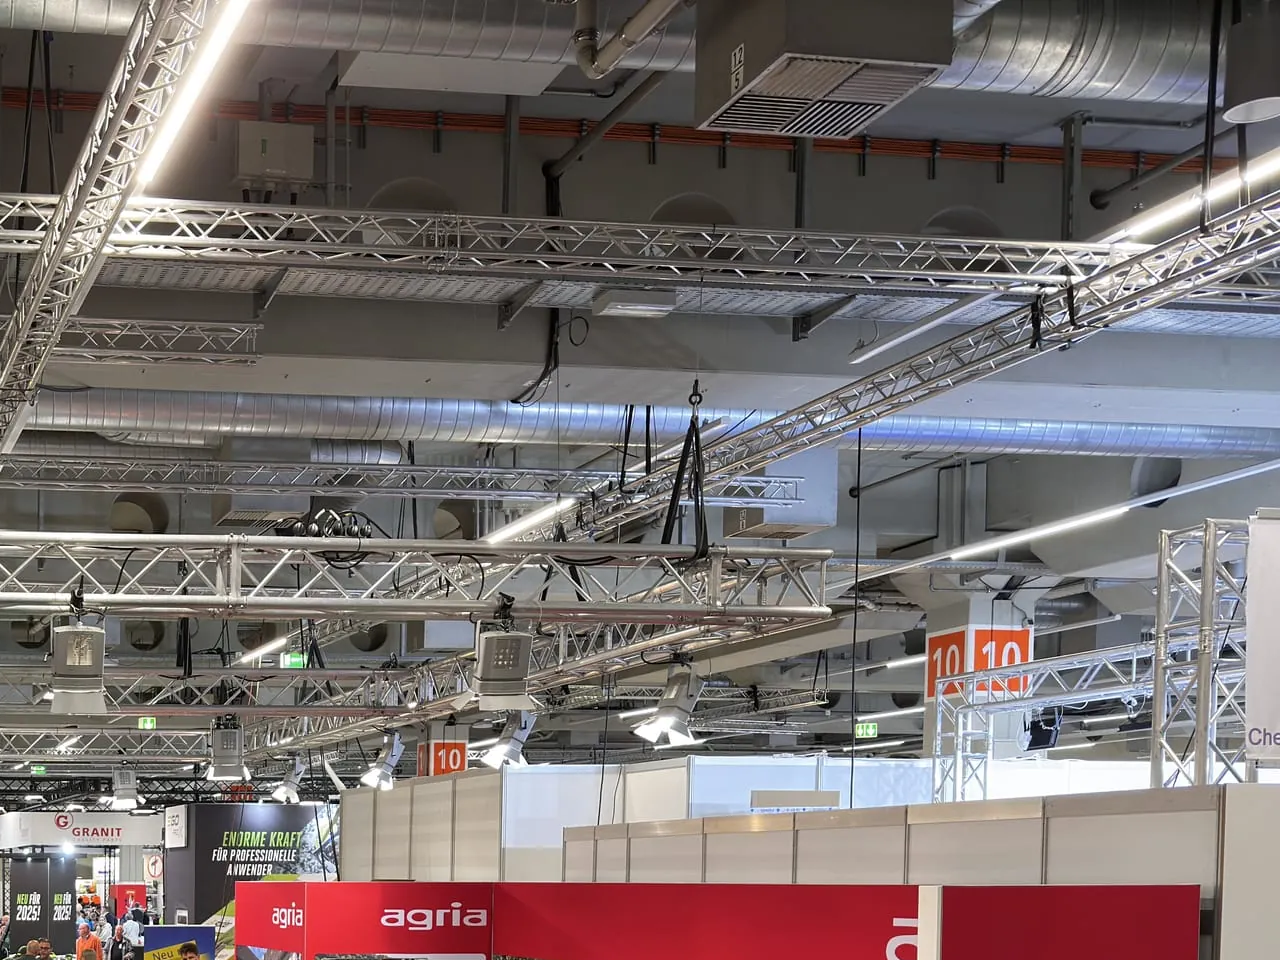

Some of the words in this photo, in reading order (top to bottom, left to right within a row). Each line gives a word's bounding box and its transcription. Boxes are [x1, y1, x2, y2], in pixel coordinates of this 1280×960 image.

[932, 643, 960, 678] 10
[982, 641, 1022, 671] 10
[437, 748, 462, 770] 10
[72, 827, 122, 837] GRANIT
[222, 831, 267, 847] ENORME
[269, 831, 303, 848] KRAFT
[211, 847, 228, 862] FÜR
[229, 849, 297, 862] PROFESSIONELLE
[226, 863, 273, 876] ANWENDER
[16, 893, 29, 905] NEU
[29, 891, 41, 905] FÜR
[16, 905, 41, 921] 2025!
[53, 905, 72, 921] 2025!
[272, 902, 303, 929] agria
[380, 901, 488, 931] agria
